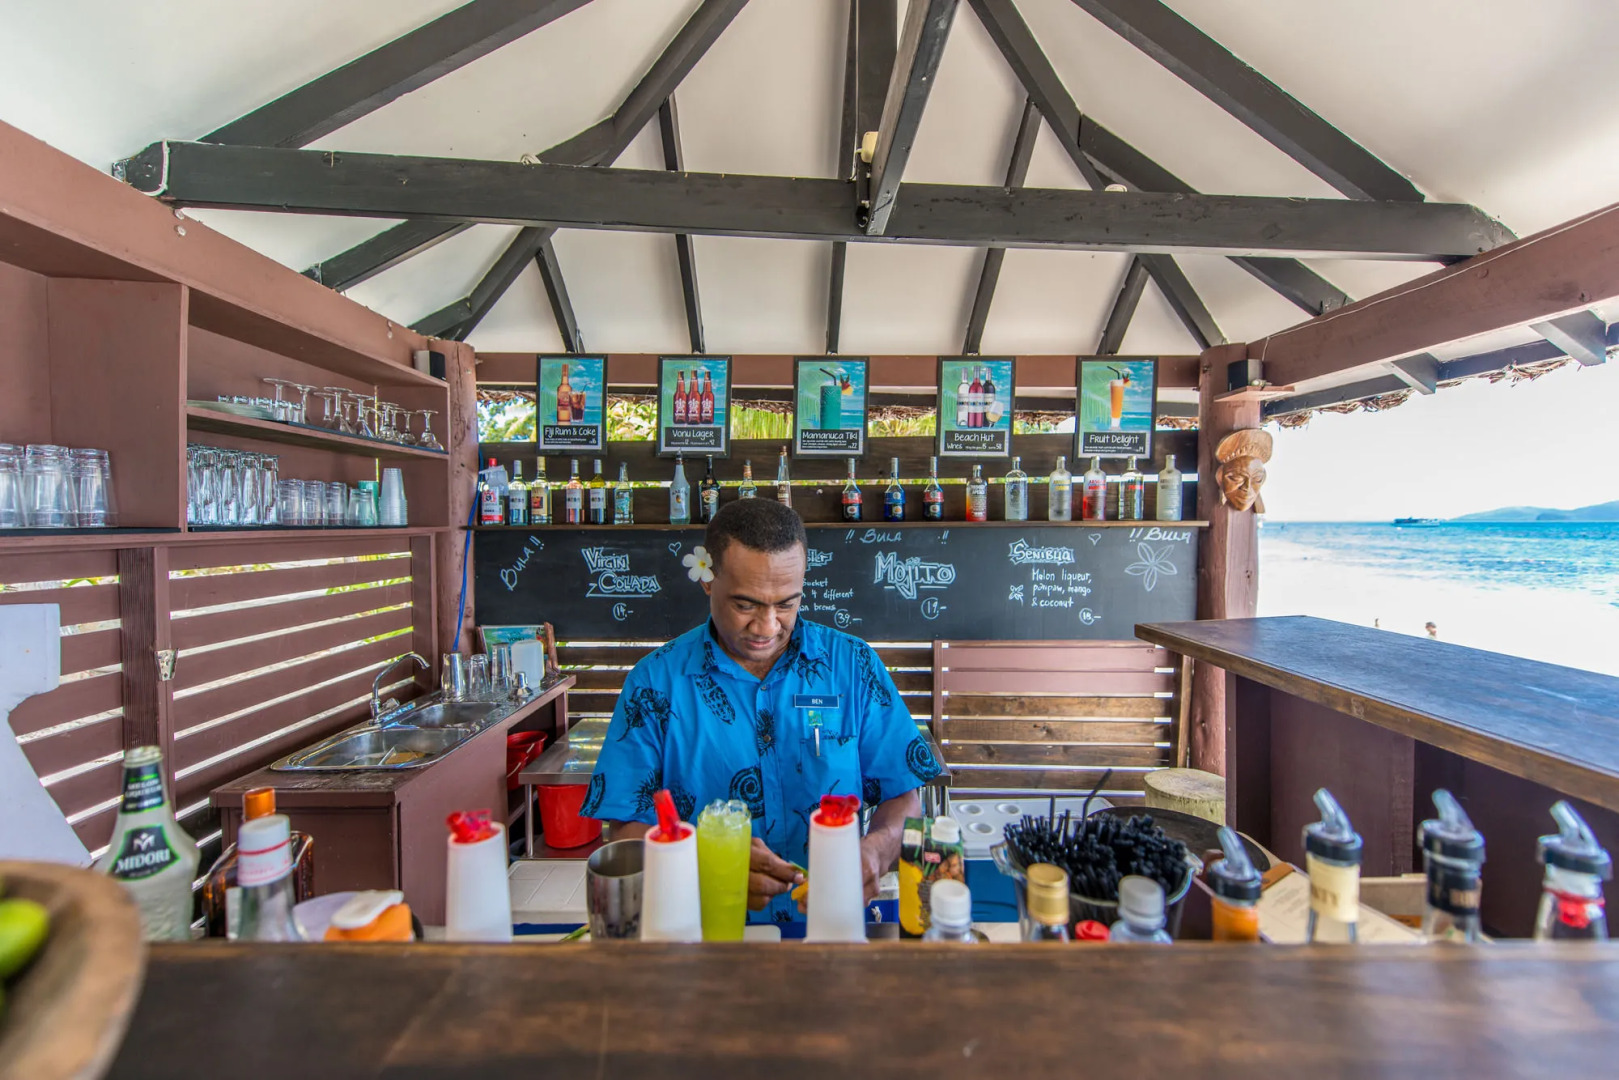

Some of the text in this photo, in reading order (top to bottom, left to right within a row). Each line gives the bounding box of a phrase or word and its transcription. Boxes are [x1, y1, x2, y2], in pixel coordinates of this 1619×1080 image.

[555, 427, 571, 436] Rum
[573, 427, 578, 436] &
[579, 427, 597, 436] Coke
[672, 430, 714, 441] Vonu Lager
[802, 431, 858, 440] Mamanuca Tiki
[954, 433, 995, 442] Beach Hut
[1089, 435, 1139, 447] Fruit Delight
[1032, 568, 1056, 581] Melon
[824, 588, 854, 601] different
[814, 602, 837, 611] brews
[1032, 597, 1075, 608] & coconut
[115, 849, 171, 873] MIDORI
